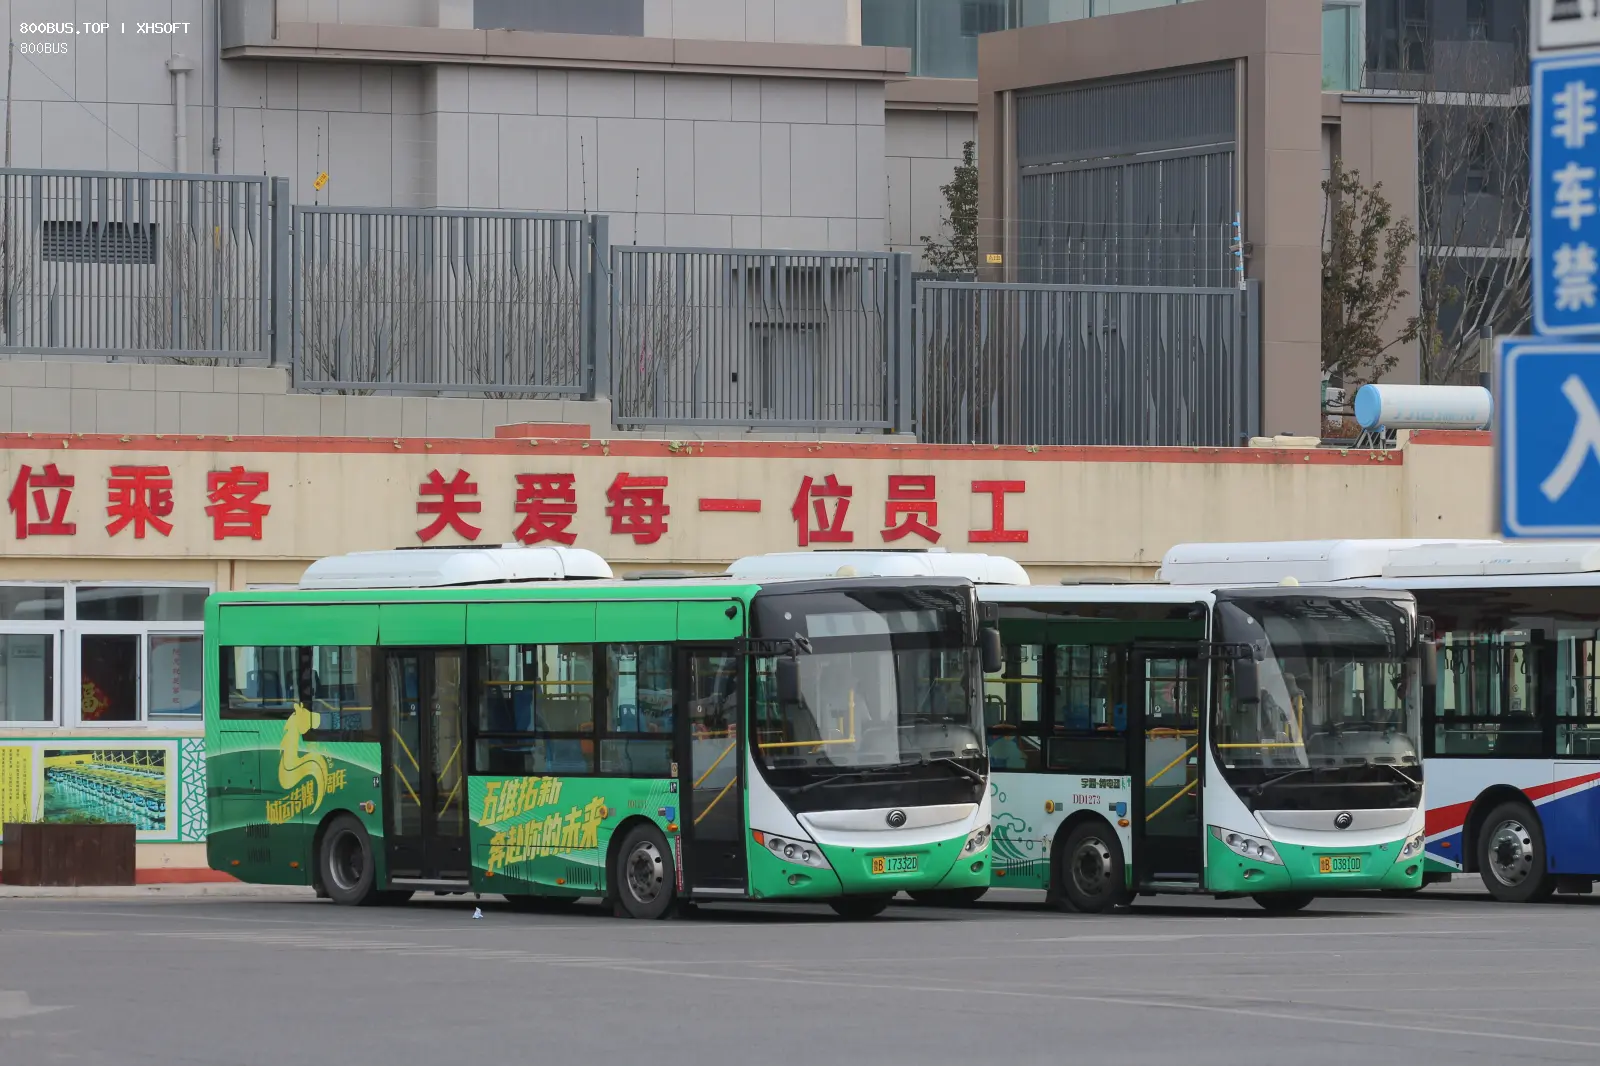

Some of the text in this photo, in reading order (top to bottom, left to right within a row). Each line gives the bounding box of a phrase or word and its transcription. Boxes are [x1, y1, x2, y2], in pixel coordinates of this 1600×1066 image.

[8, 463, 1029, 547] 位乘客 关爱每一位员工
[478, 775, 564, 827] 五维拓新
[1072, 793, 1101, 805] DD1273
[486, 795, 606, 873] 奔赴你的未来
